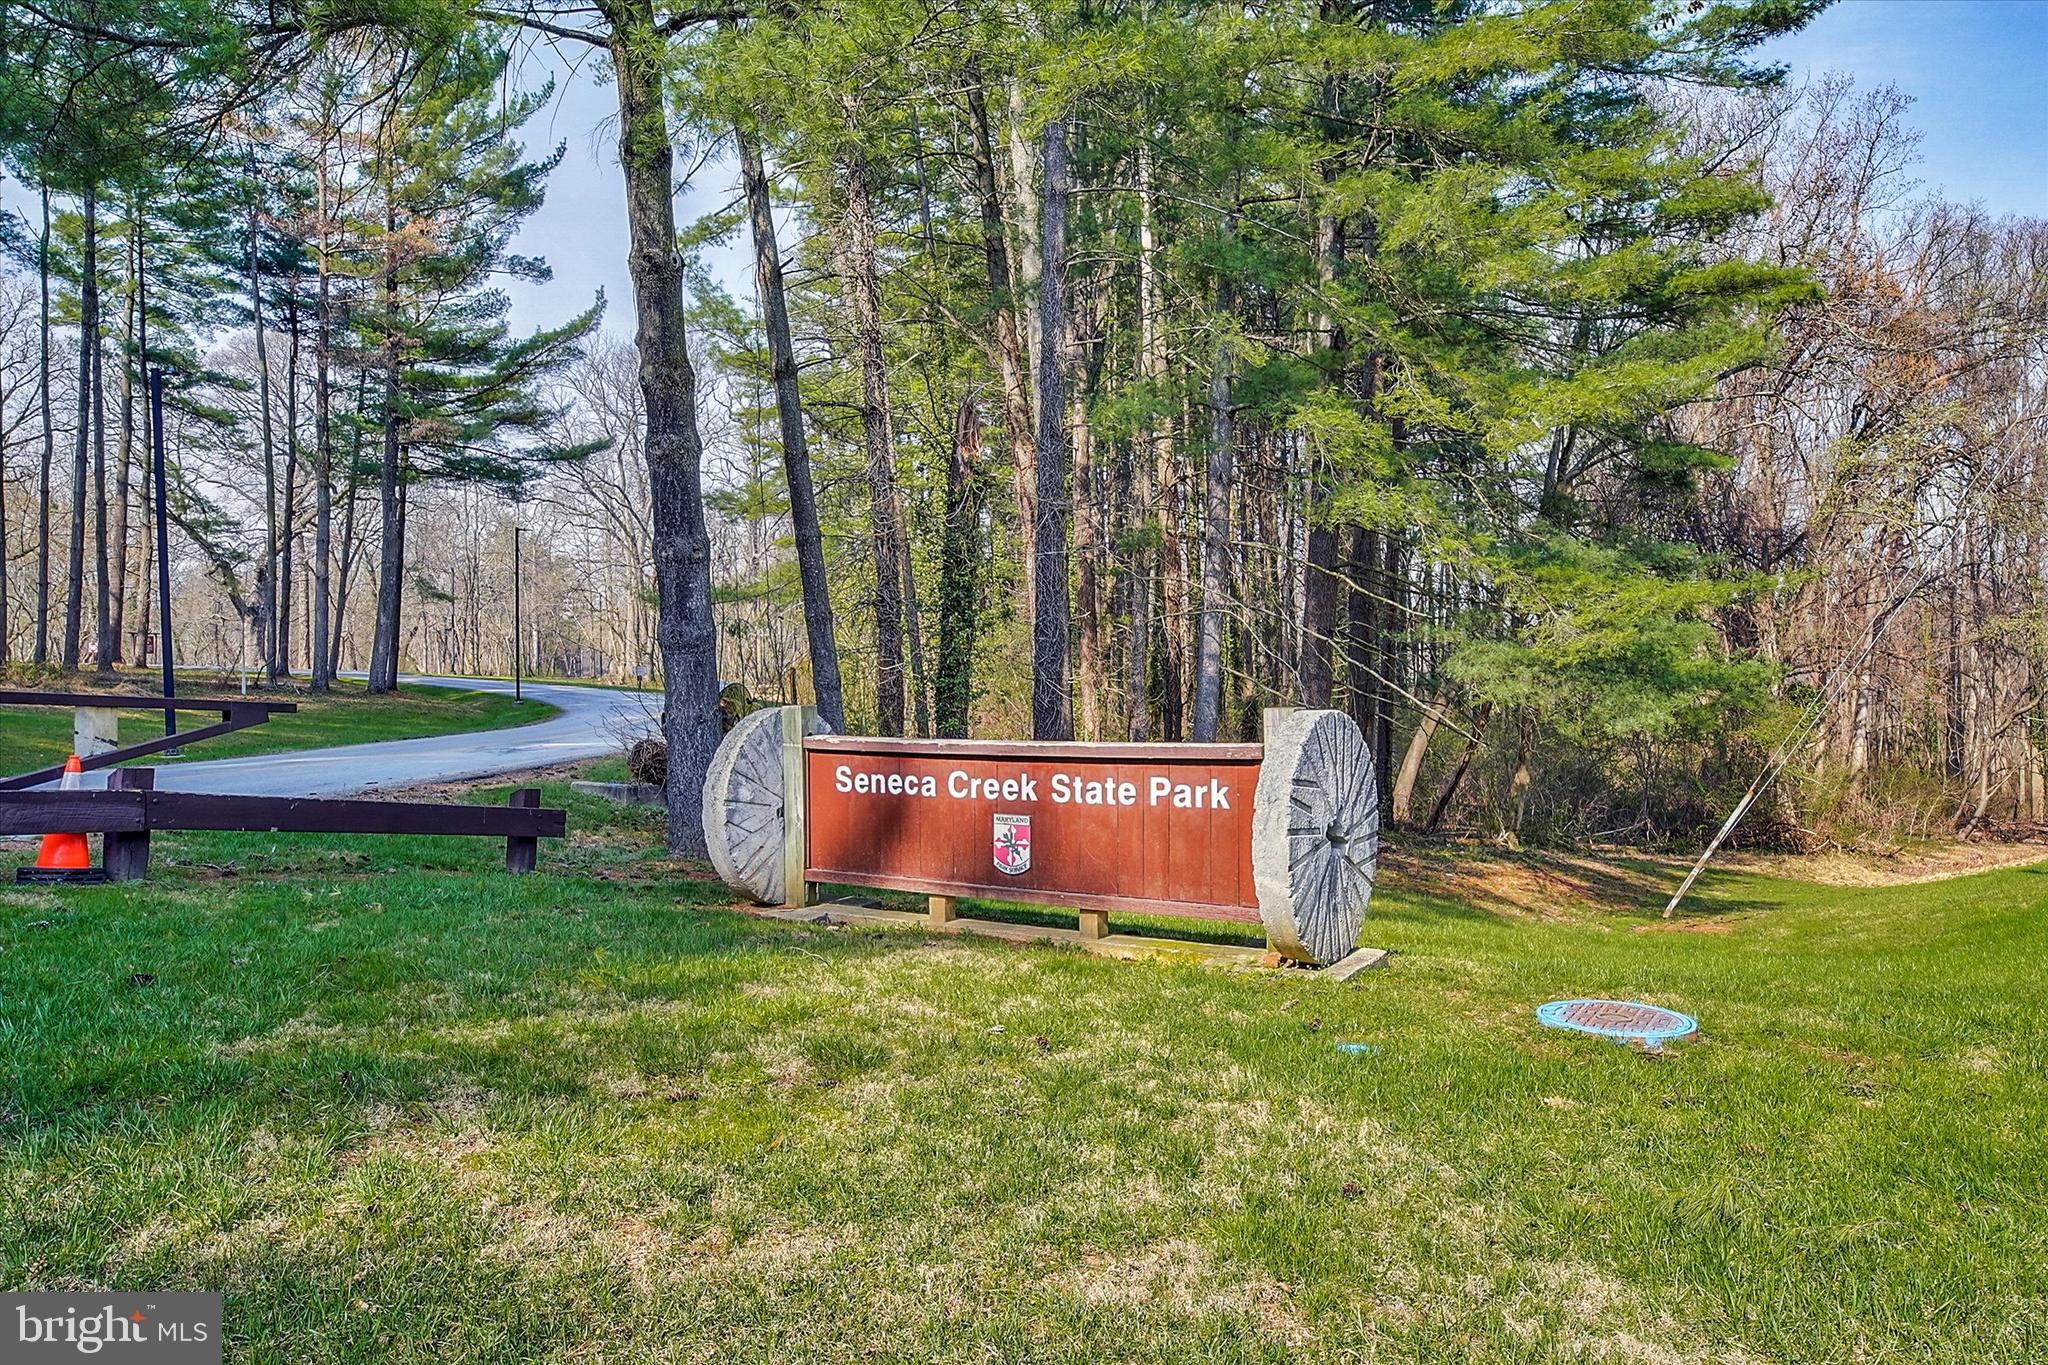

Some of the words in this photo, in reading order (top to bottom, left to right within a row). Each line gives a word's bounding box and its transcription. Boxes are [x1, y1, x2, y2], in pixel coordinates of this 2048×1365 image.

[835, 765, 937, 797] Seneca
[947, 770, 1039, 801] Creek
[1051, 773, 1137, 806] State
[1150, 776, 1231, 810] Park
[995, 816, 1029, 824] MARYLAND
